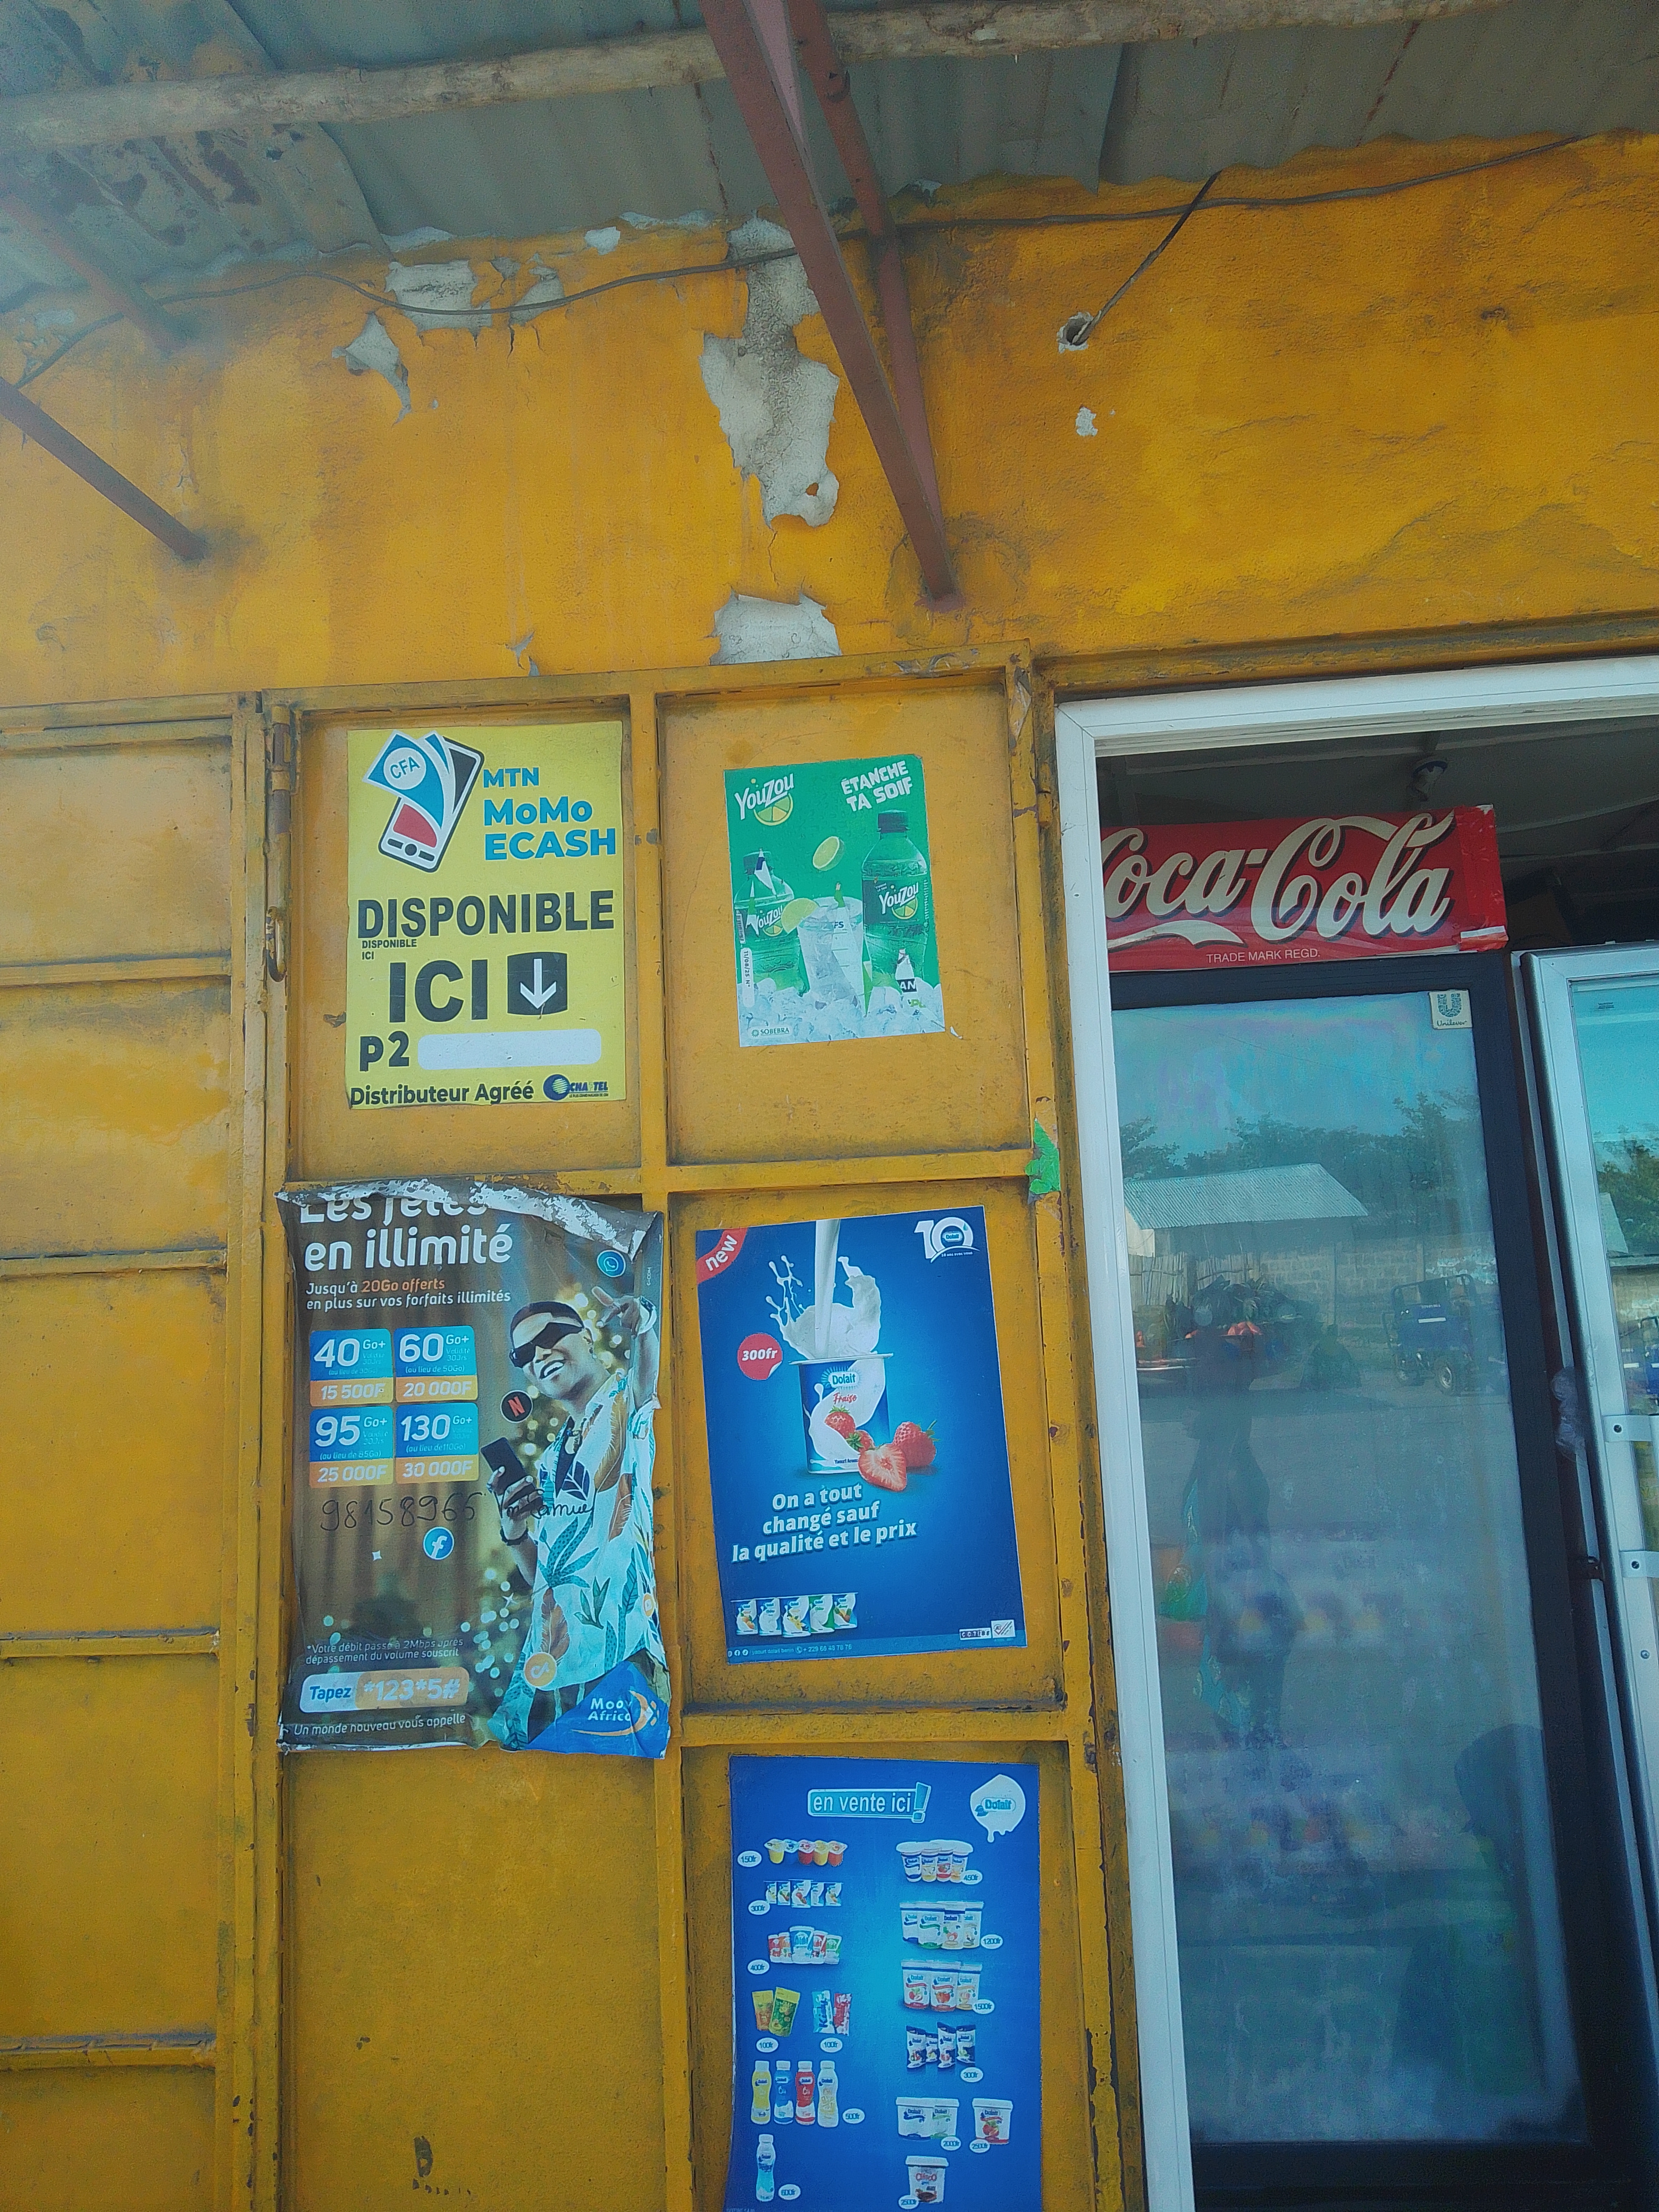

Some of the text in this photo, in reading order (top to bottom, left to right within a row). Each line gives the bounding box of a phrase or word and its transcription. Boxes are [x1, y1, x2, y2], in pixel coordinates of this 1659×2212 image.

[389, 756, 420, 780] CFA
[483, 767, 539, 788] MTN
[841, 760, 909, 795] ÉTANCHE
[846, 777, 913, 812] TA SOIF
[484, 796, 593, 826] MoMo
[484, 828, 616, 860] ECASH
[358, 890, 615, 939] DISPONIBLE
[362, 939, 417, 949] DISPONIBLE
[362, 951, 374, 960] ICI
[1206, 948, 1321, 963] TRADE MARK REGD.
[389, 959, 488, 1023] ICI
[760, 1027, 790, 1035] SOBEBRA
[360, 1030, 410, 1072] P2
[350, 1080, 534, 1106] Distributeur Agréé
[305, 1224, 513, 1271] en illimité
[704, 1233, 738, 1272] new
[306, 1278, 445, 1297] Jusqu'à 20Go offerts
[307, 1290, 511, 1312] en plus sur vos forfaits illimités
[314, 1338, 386, 1368] 40 Go+
[399, 1334, 470, 1362] 60 Go+
[742, 1347, 778, 1363] 300fr
[404, 1381, 472, 1397] 20 000F
[832, 1373, 856, 1385] Dolait
[321, 1383, 386, 1400] 15 500F
[315, 1415, 387, 1447] 95 Go+
[401, 1414, 472, 1441] 130 Go+
[317, 1465, 388, 1482] 25 000F
[403, 1461, 473, 1478] 30 000F
[773, 1482, 862, 1511] On a tout
[763, 1501, 880, 1536] changé sauf
[732, 1518, 917, 1563] la qualité et le prix
[306, 1647, 459, 1666] dépassement du volume souscrit
[338, 1642, 362, 1653] débit
[404, 1639, 435, 1650] 2Mbps
[309, 1685, 352, 1703] Tapez
[294, 1712, 466, 1736] Un monde nouveau vous appelle
[588, 1710, 631, 1722] Africa
[814, 1792, 911, 1813] en vente ici
[985, 1799, 1012, 1811] Dolait
